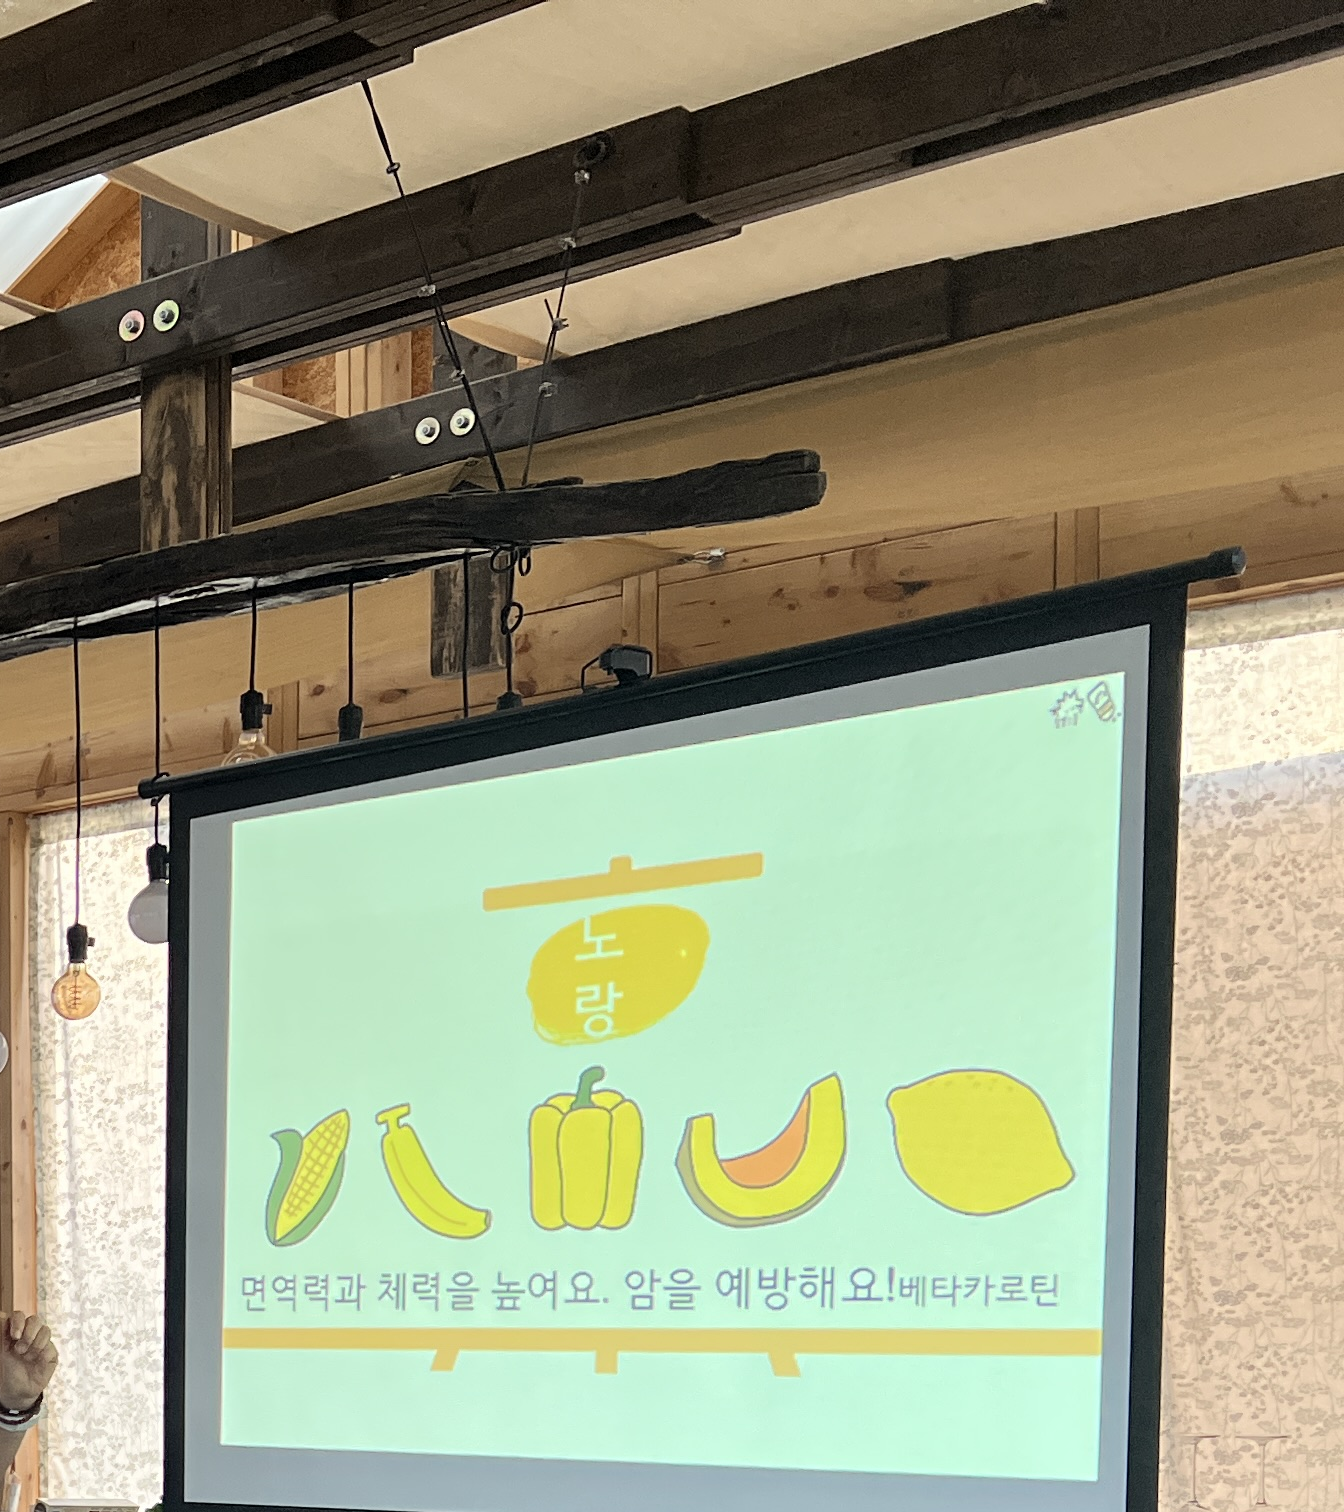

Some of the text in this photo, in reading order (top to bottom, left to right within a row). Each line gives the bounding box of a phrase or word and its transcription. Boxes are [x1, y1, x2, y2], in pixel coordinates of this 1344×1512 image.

[241, 1272, 367, 1313] 면역력과
[378, 1270, 480, 1312] 체력을
[491, 1269, 610, 1312] 높여요.
[624, 1267, 702, 1311] 암을
